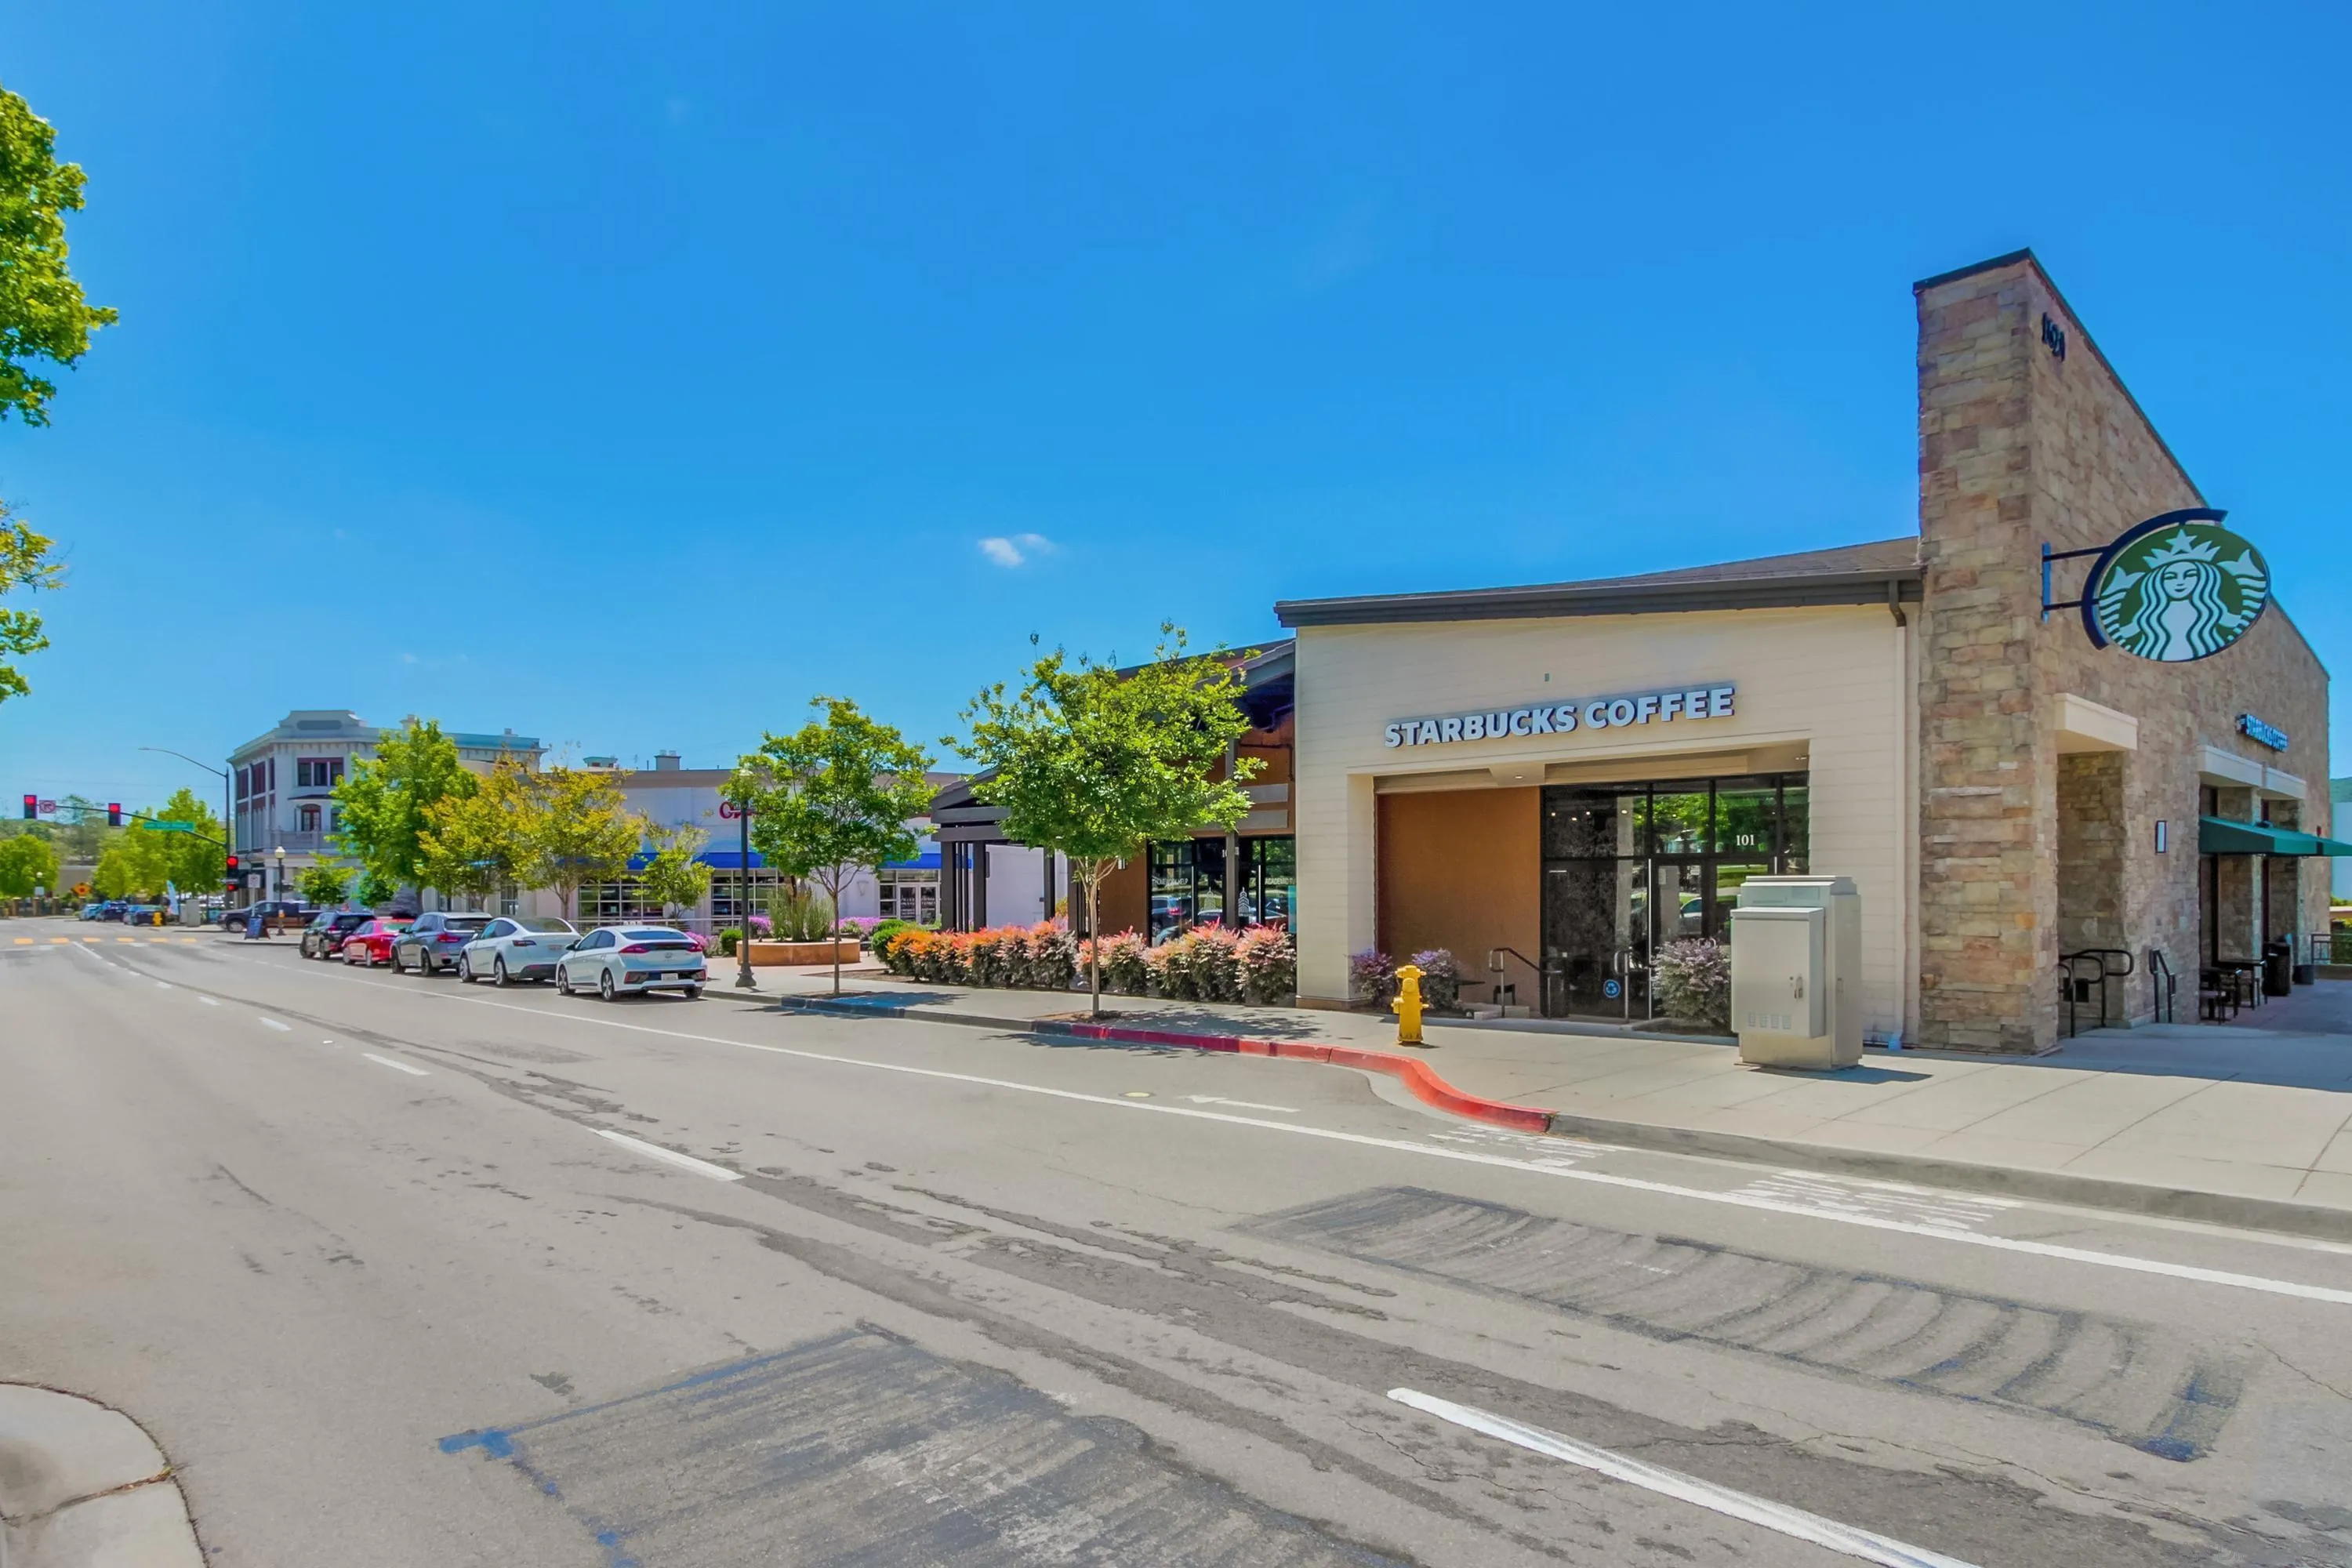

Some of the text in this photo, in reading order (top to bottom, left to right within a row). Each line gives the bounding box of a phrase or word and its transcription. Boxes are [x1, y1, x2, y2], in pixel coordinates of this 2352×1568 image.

[1385, 688, 1735, 748] STARBUCKS COFFEE
[1736, 834, 1755, 846] 101
